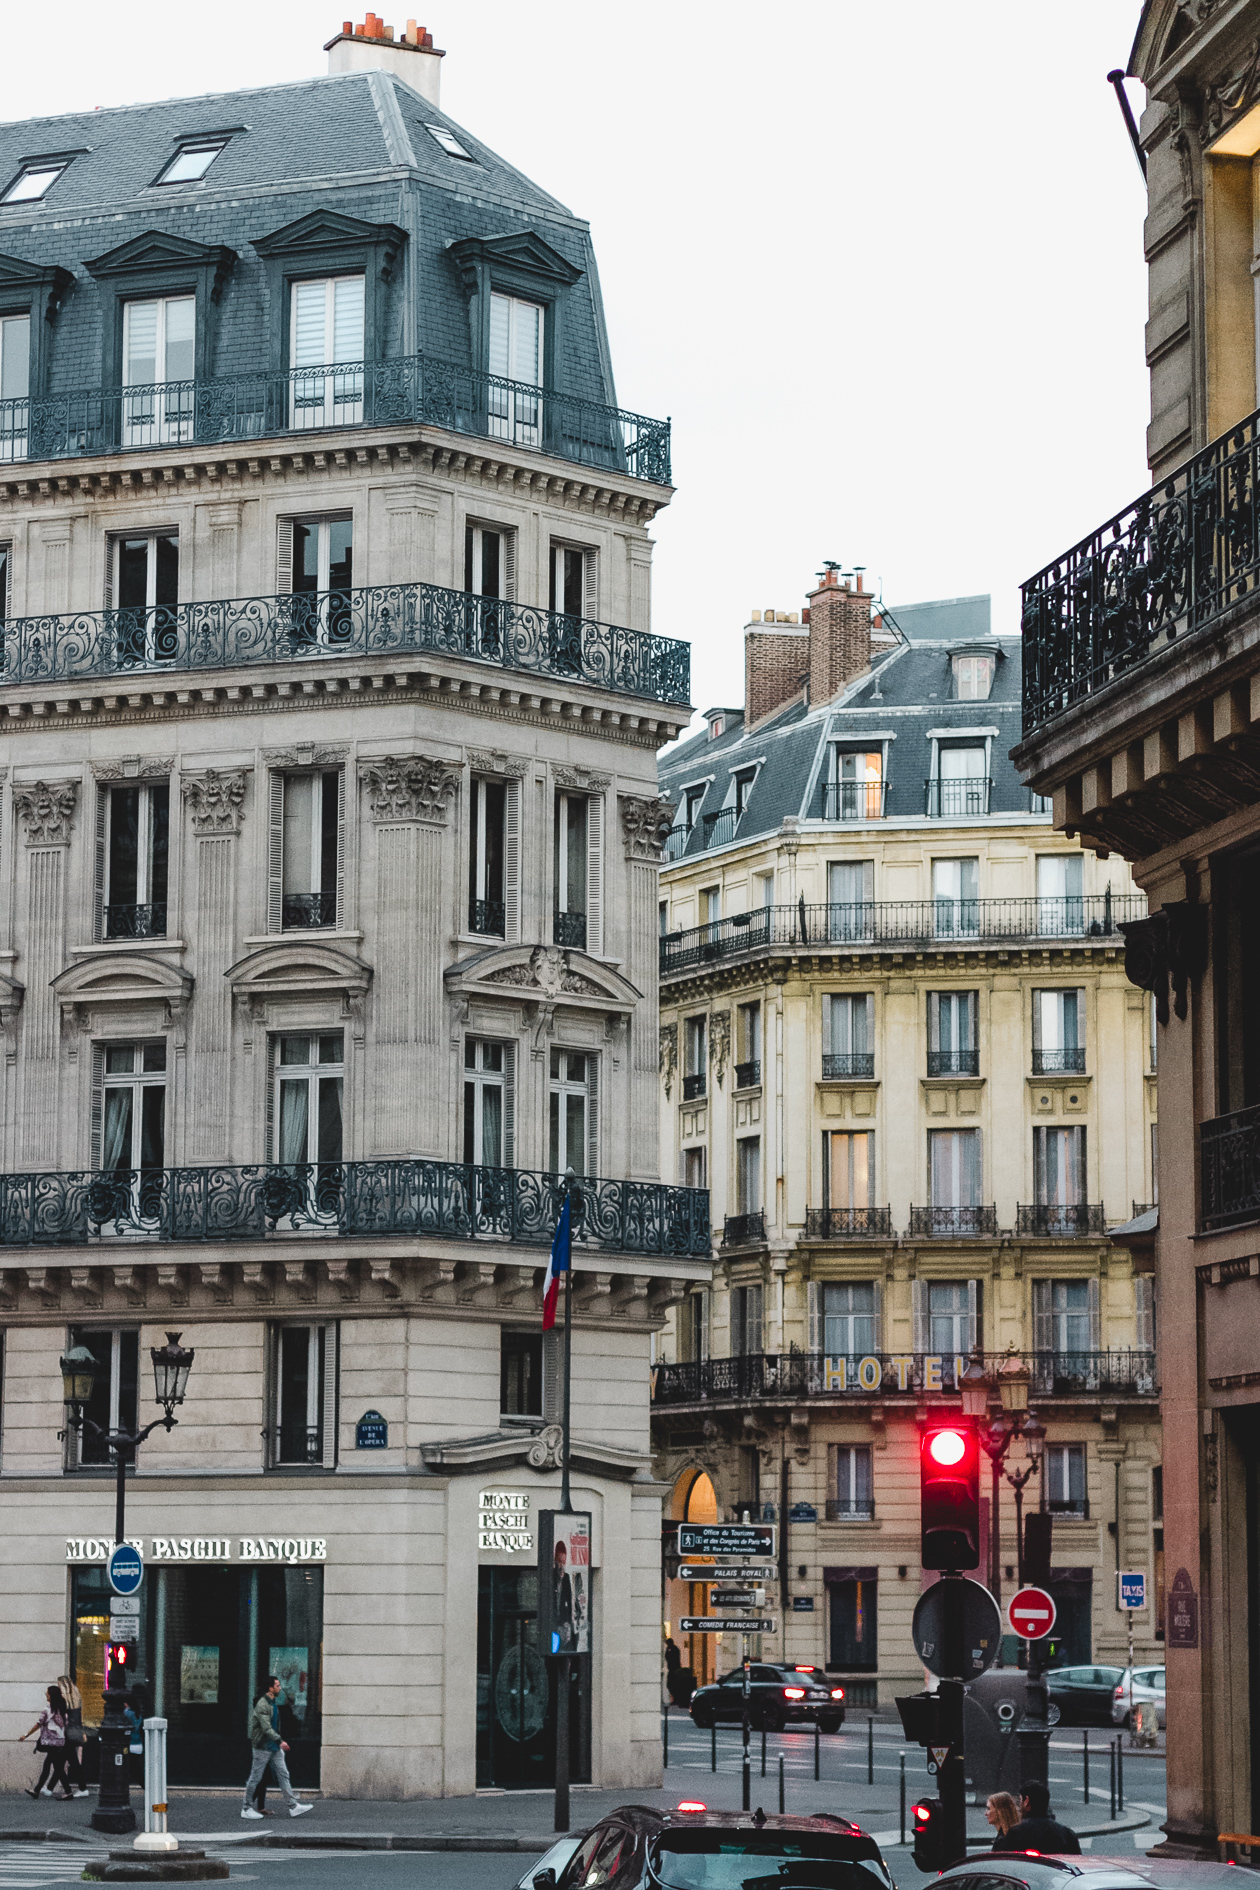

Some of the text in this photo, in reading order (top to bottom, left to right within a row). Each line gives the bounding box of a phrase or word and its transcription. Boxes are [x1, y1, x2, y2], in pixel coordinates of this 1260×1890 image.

[480, 1493, 530, 1509] MONTE
[479, 1512, 529, 1529] PASCHI
[703, 1528, 720, 1536] Office
[731, 1529, 755, 1537] Tourisme
[479, 1532, 534, 1552] BANQUE
[719, 1537, 740, 1546] Congrès
[65, 1538, 327, 1564] MONE PASCHI BANQUE
[714, 1569, 762, 1577] PALAIS ROYAL
[1122, 1585, 1144, 1597] TAXIS
[698, 1621, 724, 1629] COMEDIE
